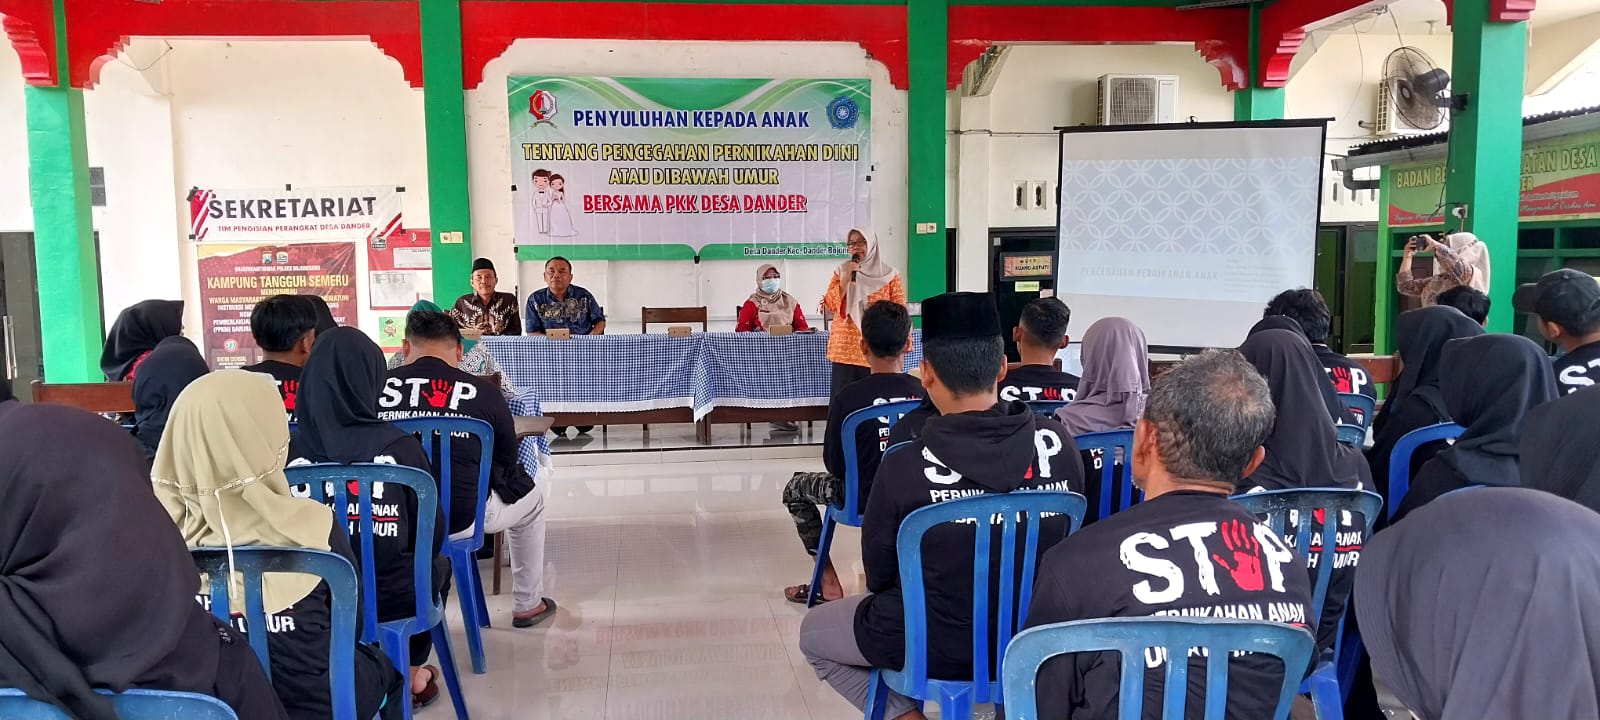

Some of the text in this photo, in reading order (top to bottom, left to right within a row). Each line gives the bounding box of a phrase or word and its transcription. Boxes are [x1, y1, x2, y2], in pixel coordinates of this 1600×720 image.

[573, 110, 810, 128] PENYULUHAN KEPADA ANAK
[522, 143, 859, 161] TENTANG PENCEGAHAN PERNIKAHAN DINI
[1560, 145, 1597, 170] DESA
[608, 168, 780, 185] ATAU DIBAWAH UMUR
[1397, 168, 1431, 188] BADAN
[208, 197, 377, 219] SEKRETARIAT
[582, 194, 808, 213] BERSAMA PKK DESA DANDER
[275, 224, 318, 232] PERANGKAT
[744, 247, 761, 256] Desa
[762, 247, 787, 256] Dander
[803, 247, 827, 255] Dander
[207, 274, 349, 289] KAMPUNG TANGGUH SEMERU
